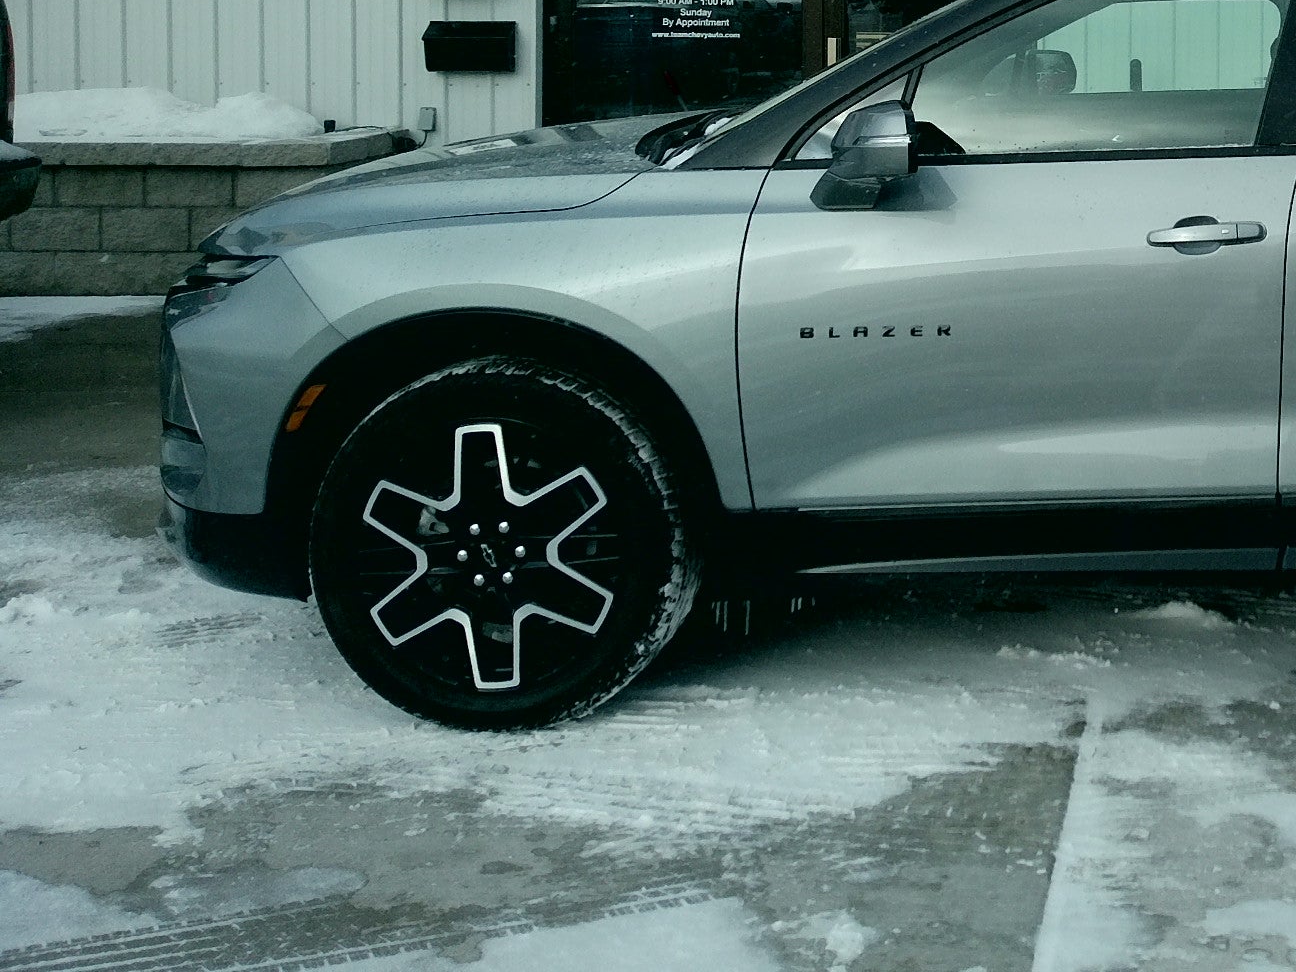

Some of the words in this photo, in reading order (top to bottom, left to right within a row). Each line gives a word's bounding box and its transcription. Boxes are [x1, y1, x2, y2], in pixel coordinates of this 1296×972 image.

[679, 8, 713, 19] Sunday
[662, 17, 675, 28] By
[675, 17, 730, 28] Appointment
[799, 325, 952, 339] BLAZER
